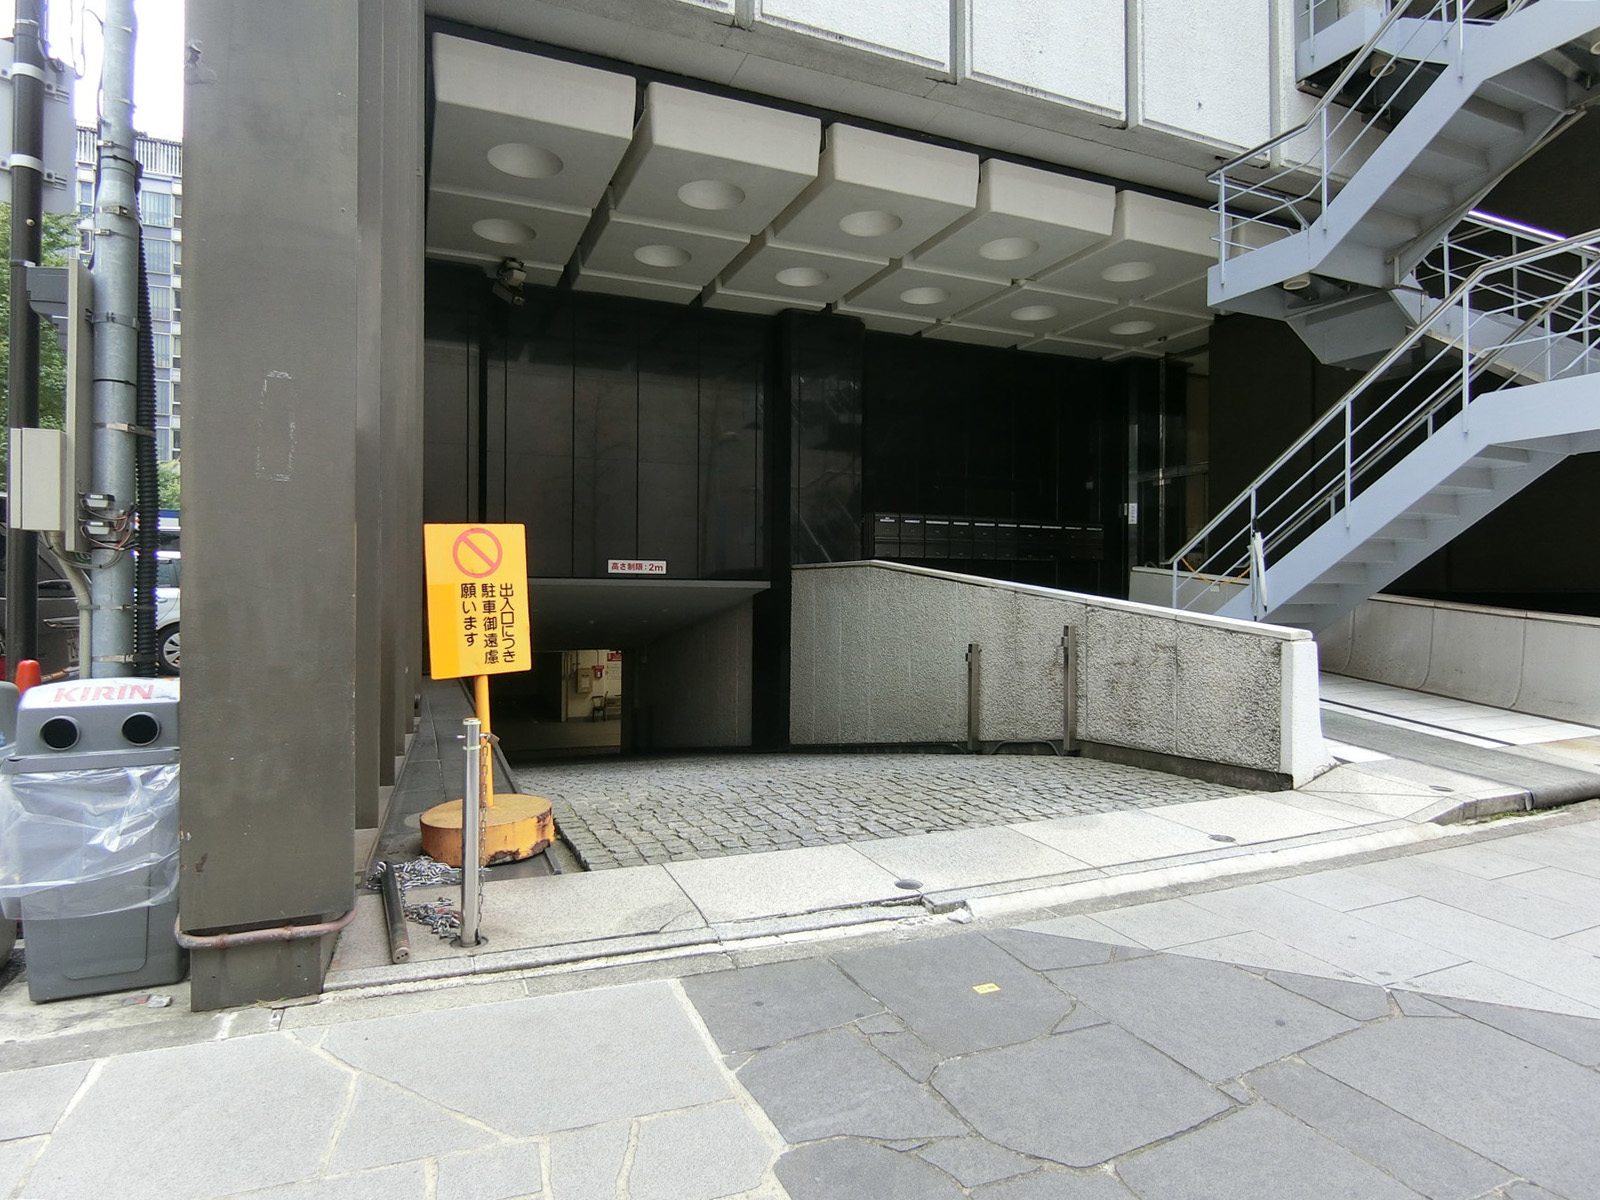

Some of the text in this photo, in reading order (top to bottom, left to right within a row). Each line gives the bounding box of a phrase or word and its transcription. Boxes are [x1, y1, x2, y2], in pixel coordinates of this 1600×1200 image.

[460, 582, 479, 647] 願います
[481, 583, 500, 664] 駐車御遠慮
[500, 582, 516, 663] 出入口につき
[53, 684, 154, 703] KIRIN
